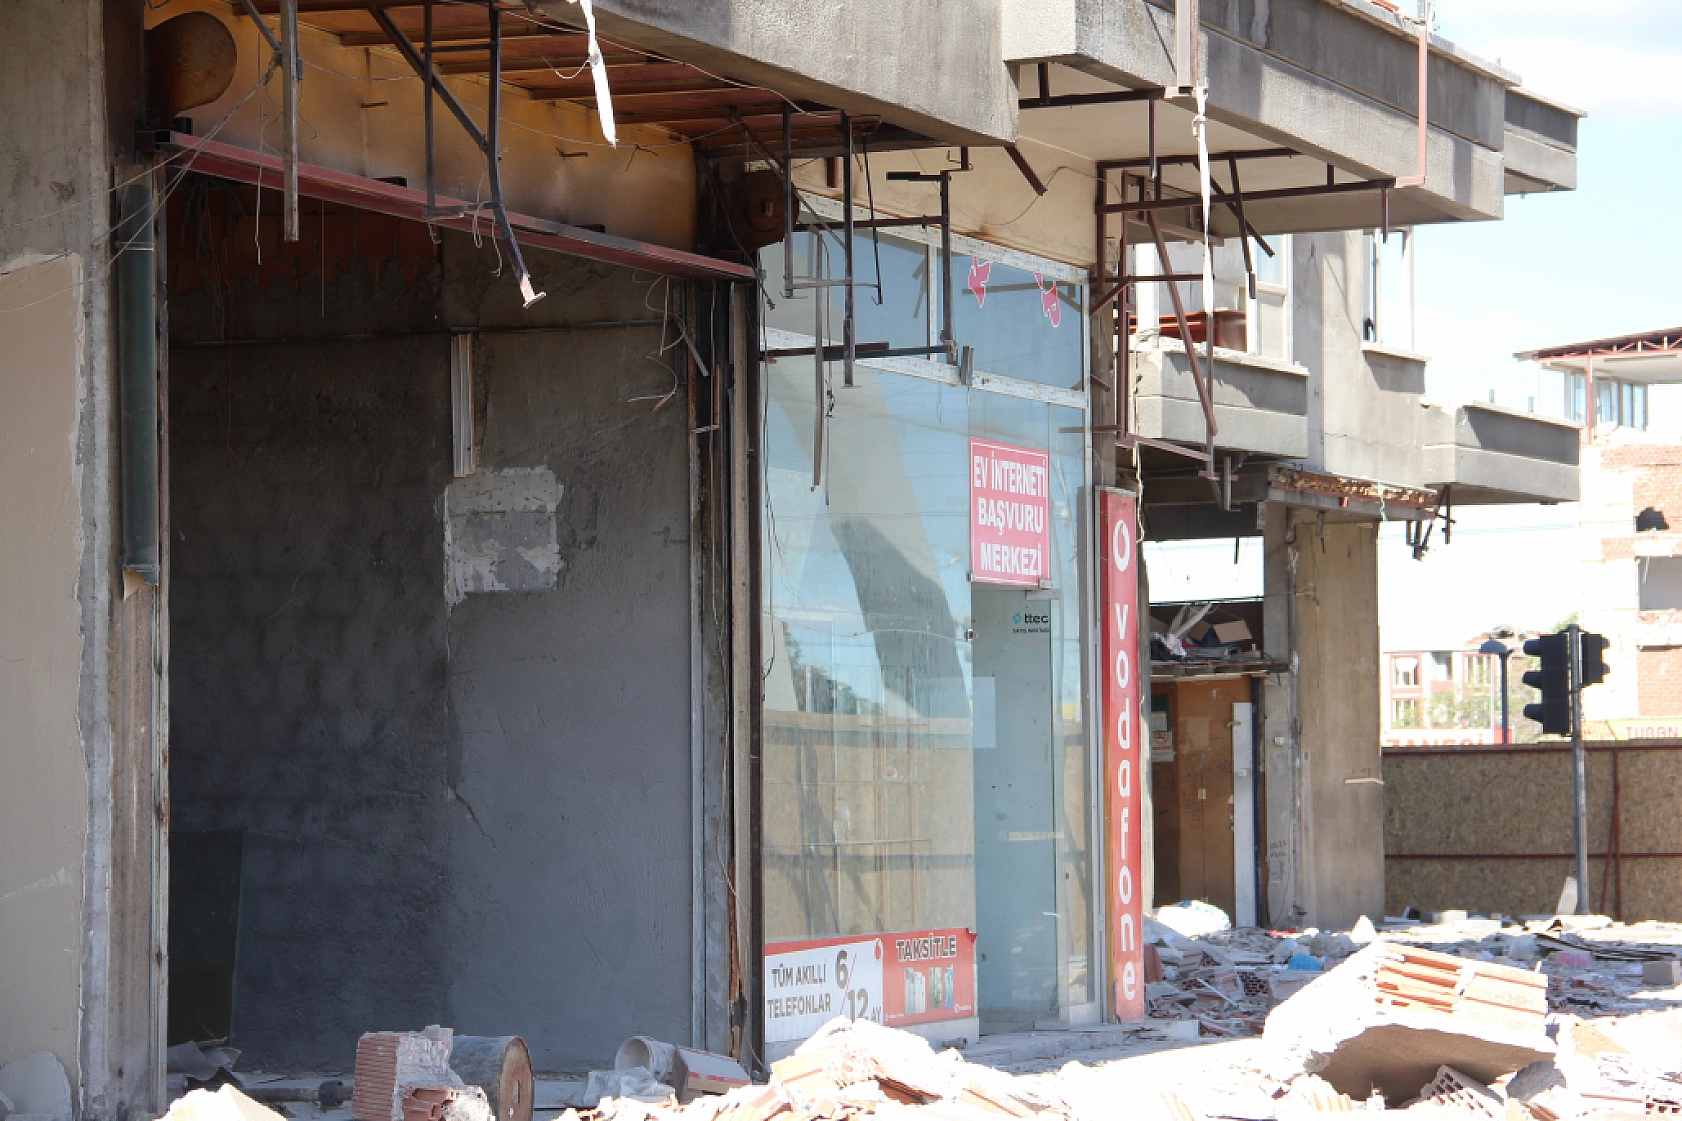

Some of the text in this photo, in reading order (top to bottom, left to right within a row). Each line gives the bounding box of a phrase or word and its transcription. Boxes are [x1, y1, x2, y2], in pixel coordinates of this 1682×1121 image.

[974, 451, 1046, 497] EV İNTERNETİ
[978, 497, 1044, 535] BAŞVURU
[980, 542, 1042, 576] MERKEZİ
[1024, 613, 1049, 624] ttec
[1114, 602, 1135, 1000] vodafone
[896, 933, 957, 962] TAKSİTLE
[771, 962, 793, 987] TÜM
[796, 963, 826, 985] AKILLI
[767, 993, 831, 1018] TELEFONLAR
[871, 1006, 882, 1023] AY
